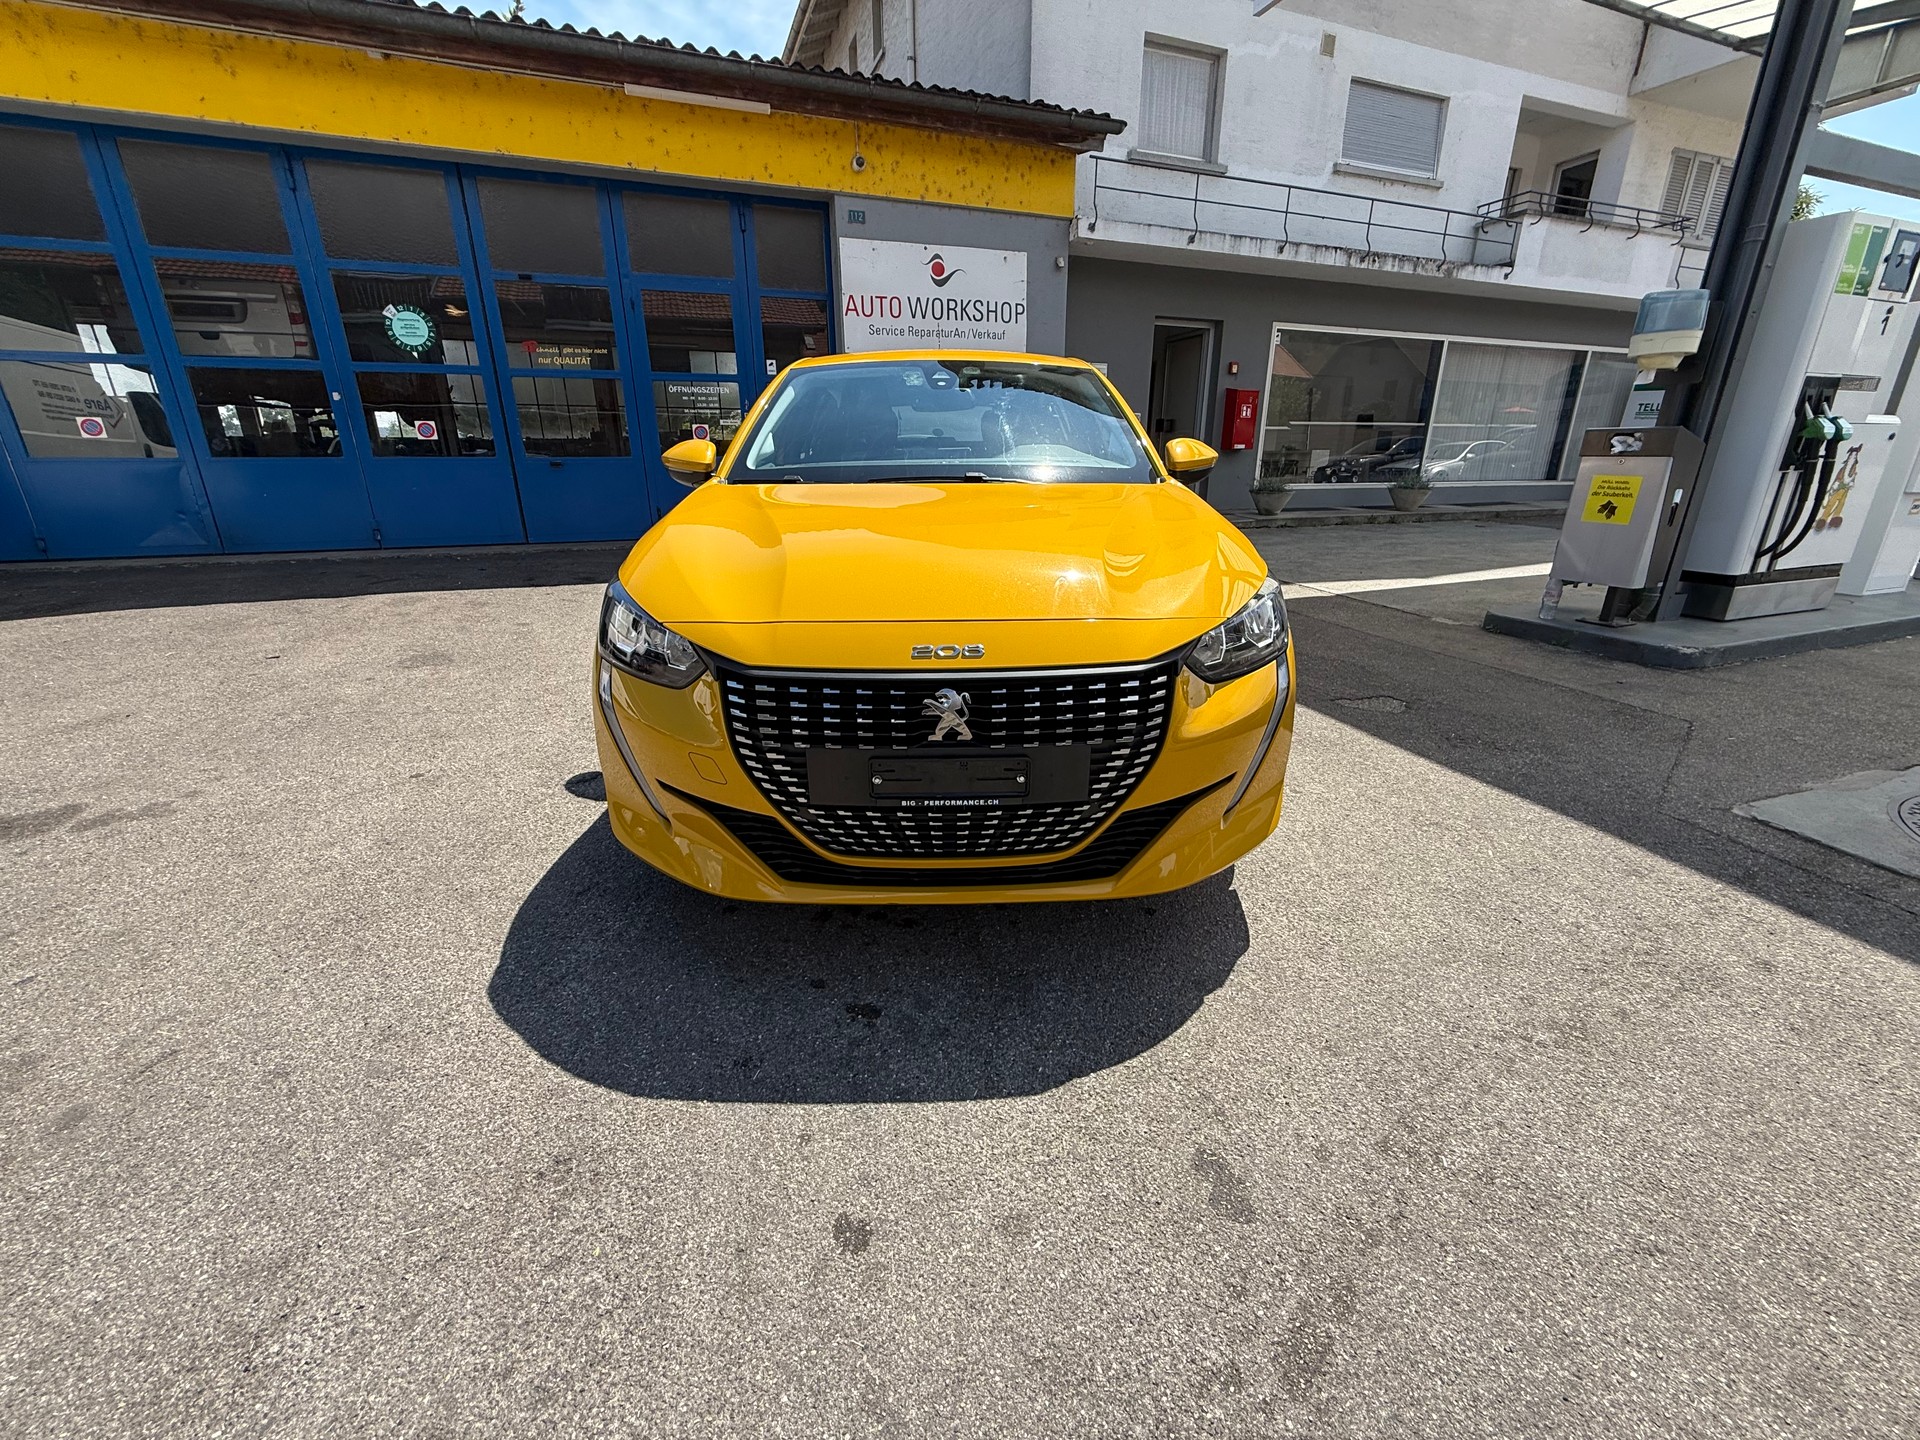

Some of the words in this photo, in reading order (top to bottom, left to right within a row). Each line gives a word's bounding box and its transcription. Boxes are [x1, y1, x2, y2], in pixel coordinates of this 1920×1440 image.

[850, 211, 864, 222] 112
[844, 294, 903, 319] AUTO
[906, 296, 1026, 324] WORKSHOP
[868, 324, 905, 337] Service
[553, 356, 591, 365] QUALITÄT
[668, 384, 730, 394] ÖFFNUNGSZEITEN
[1638, 402, 1660, 412] TELL
[911, 644, 985, 660] 208
